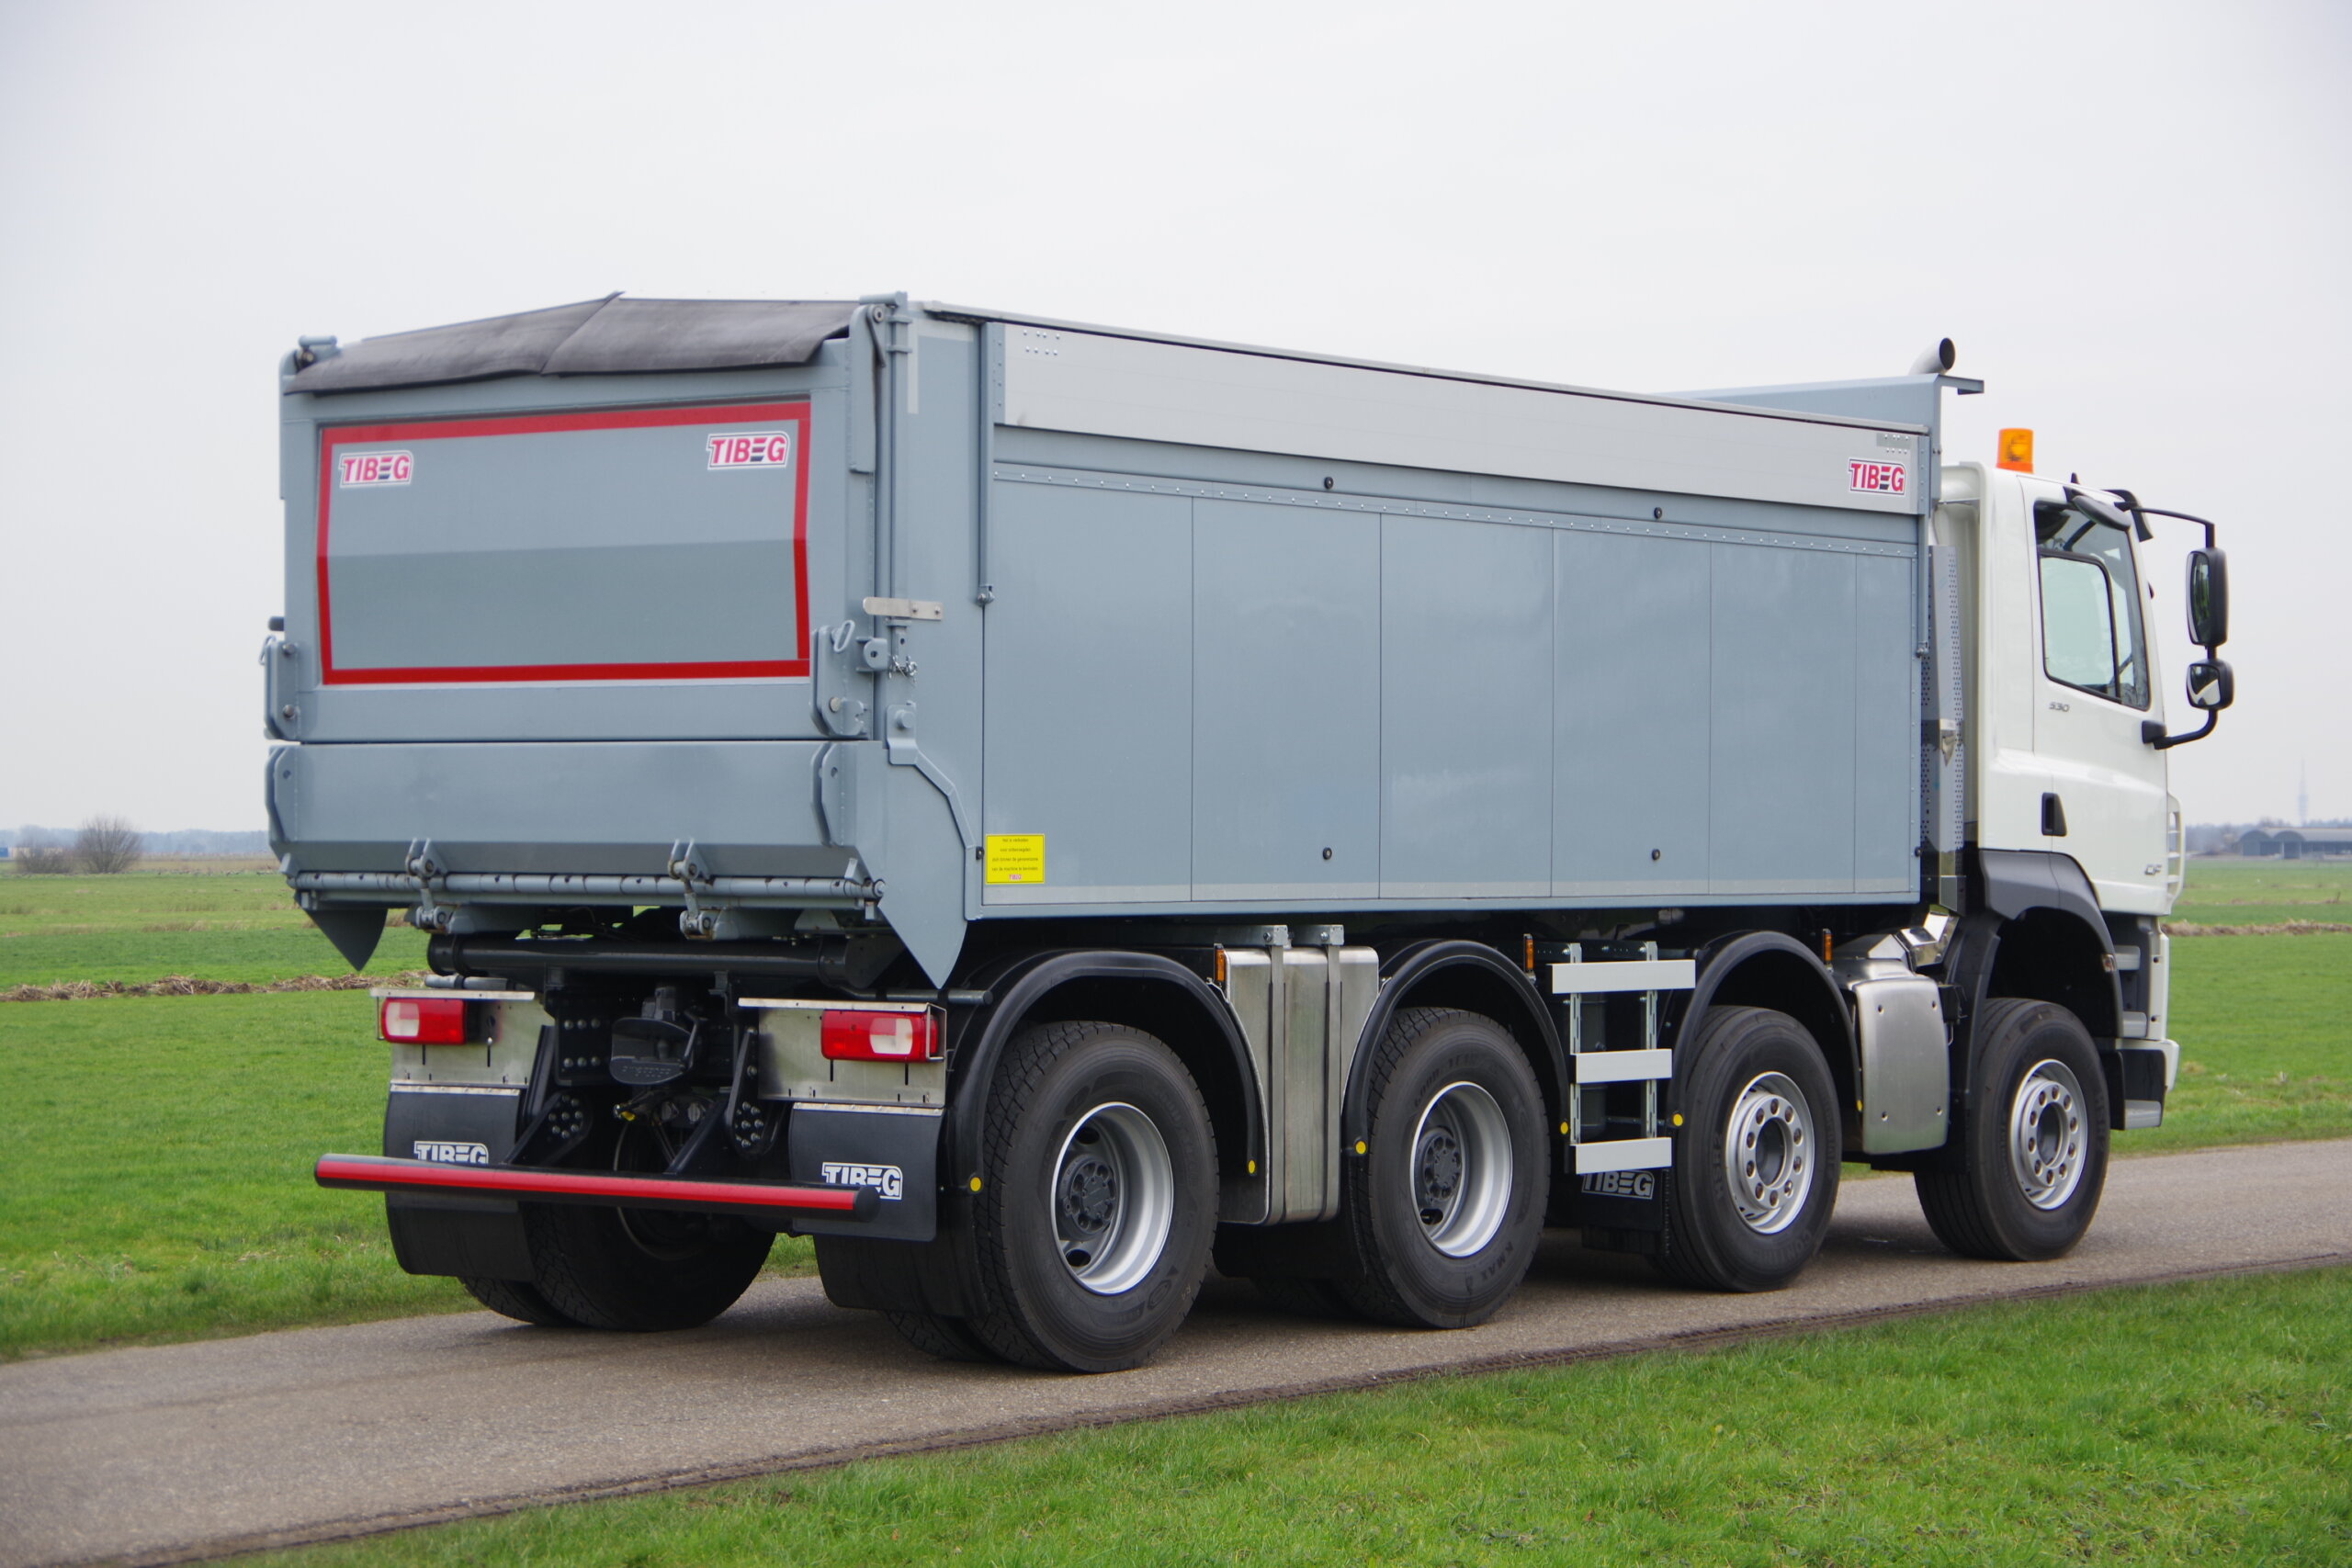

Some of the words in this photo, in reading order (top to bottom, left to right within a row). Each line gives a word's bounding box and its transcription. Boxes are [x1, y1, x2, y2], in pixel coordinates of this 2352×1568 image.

[711, 436, 786, 464] TIBEG
[343, 455, 410, 482] TIBEG
[1850, 463, 1905, 491] TIBEG
